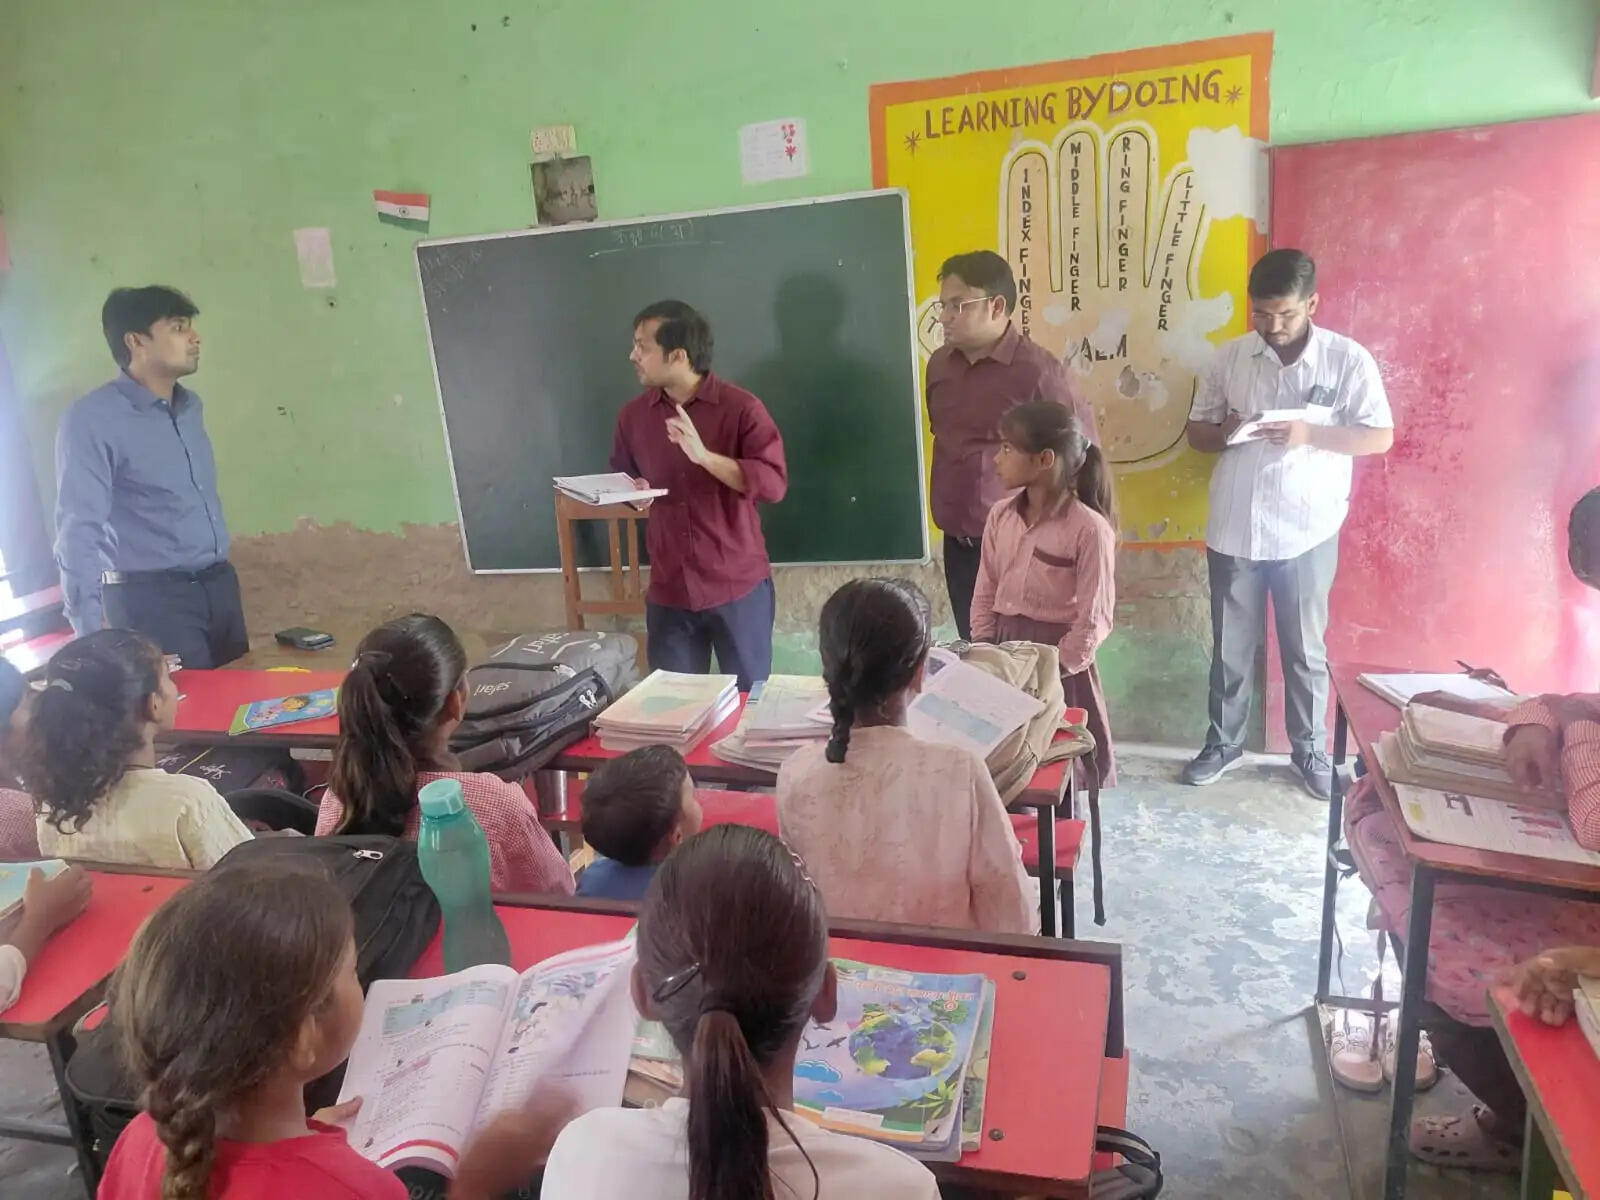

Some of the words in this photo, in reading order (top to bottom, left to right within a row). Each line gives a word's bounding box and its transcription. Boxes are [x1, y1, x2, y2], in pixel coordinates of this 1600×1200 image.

[924, 91, 1058, 140] LEARNING
[1070, 142, 1082, 219] MIDDLE
[1119, 136, 1131, 194] RING
[1021, 167, 1033, 243] INDEX
[1171, 175, 1194, 247] LITTLE
[1069, 226, 1082, 312] FINGER
[1118, 199, 1130, 292] FINGER
[1018, 247, 1033, 338] FINGER
[1157, 253, 1176, 332] FINGER
